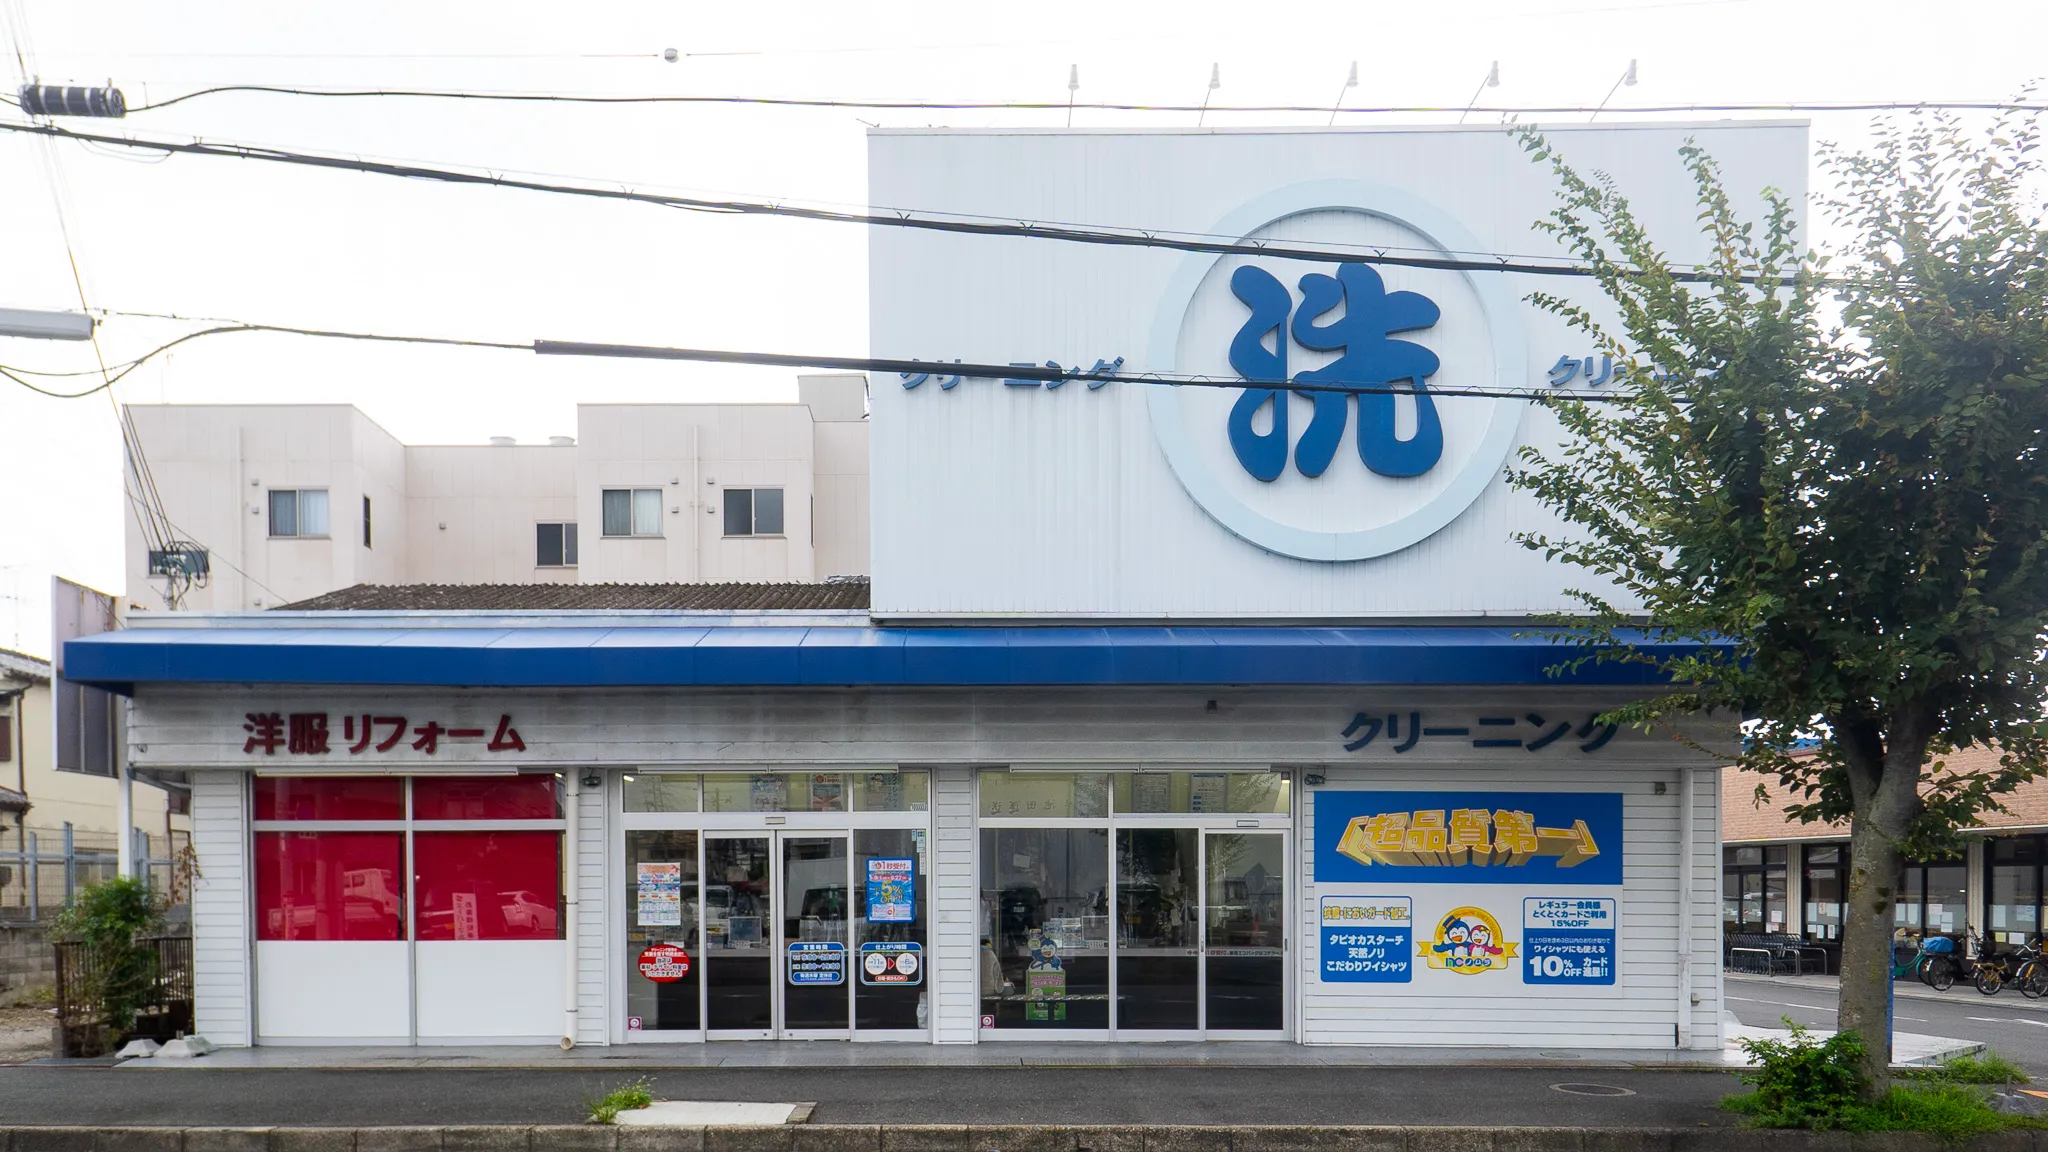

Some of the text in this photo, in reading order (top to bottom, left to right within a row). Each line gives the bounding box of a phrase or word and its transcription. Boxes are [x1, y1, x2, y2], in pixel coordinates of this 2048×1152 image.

[1227, 264, 1444, 483] 洗
[243, 712, 527, 755] 洋服 リフォーム
[1341, 711, 1619, 753] クリーニング
[1336, 808, 1600, 865] 「超品質第一」
[1539, 901, 1601, 909] レギュラー会員様
[1532, 910, 1607, 919] とくとくカードご利用
[1329, 934, 1404, 946] タピオカスターチ
[1348, 947, 1385, 959] 天然ノリ
[1534, 945, 1606, 953] ワイシャツにも使える
[1326, 960, 1407, 972] こだわりワイシャツ
[1583, 957, 1608, 967] カード
